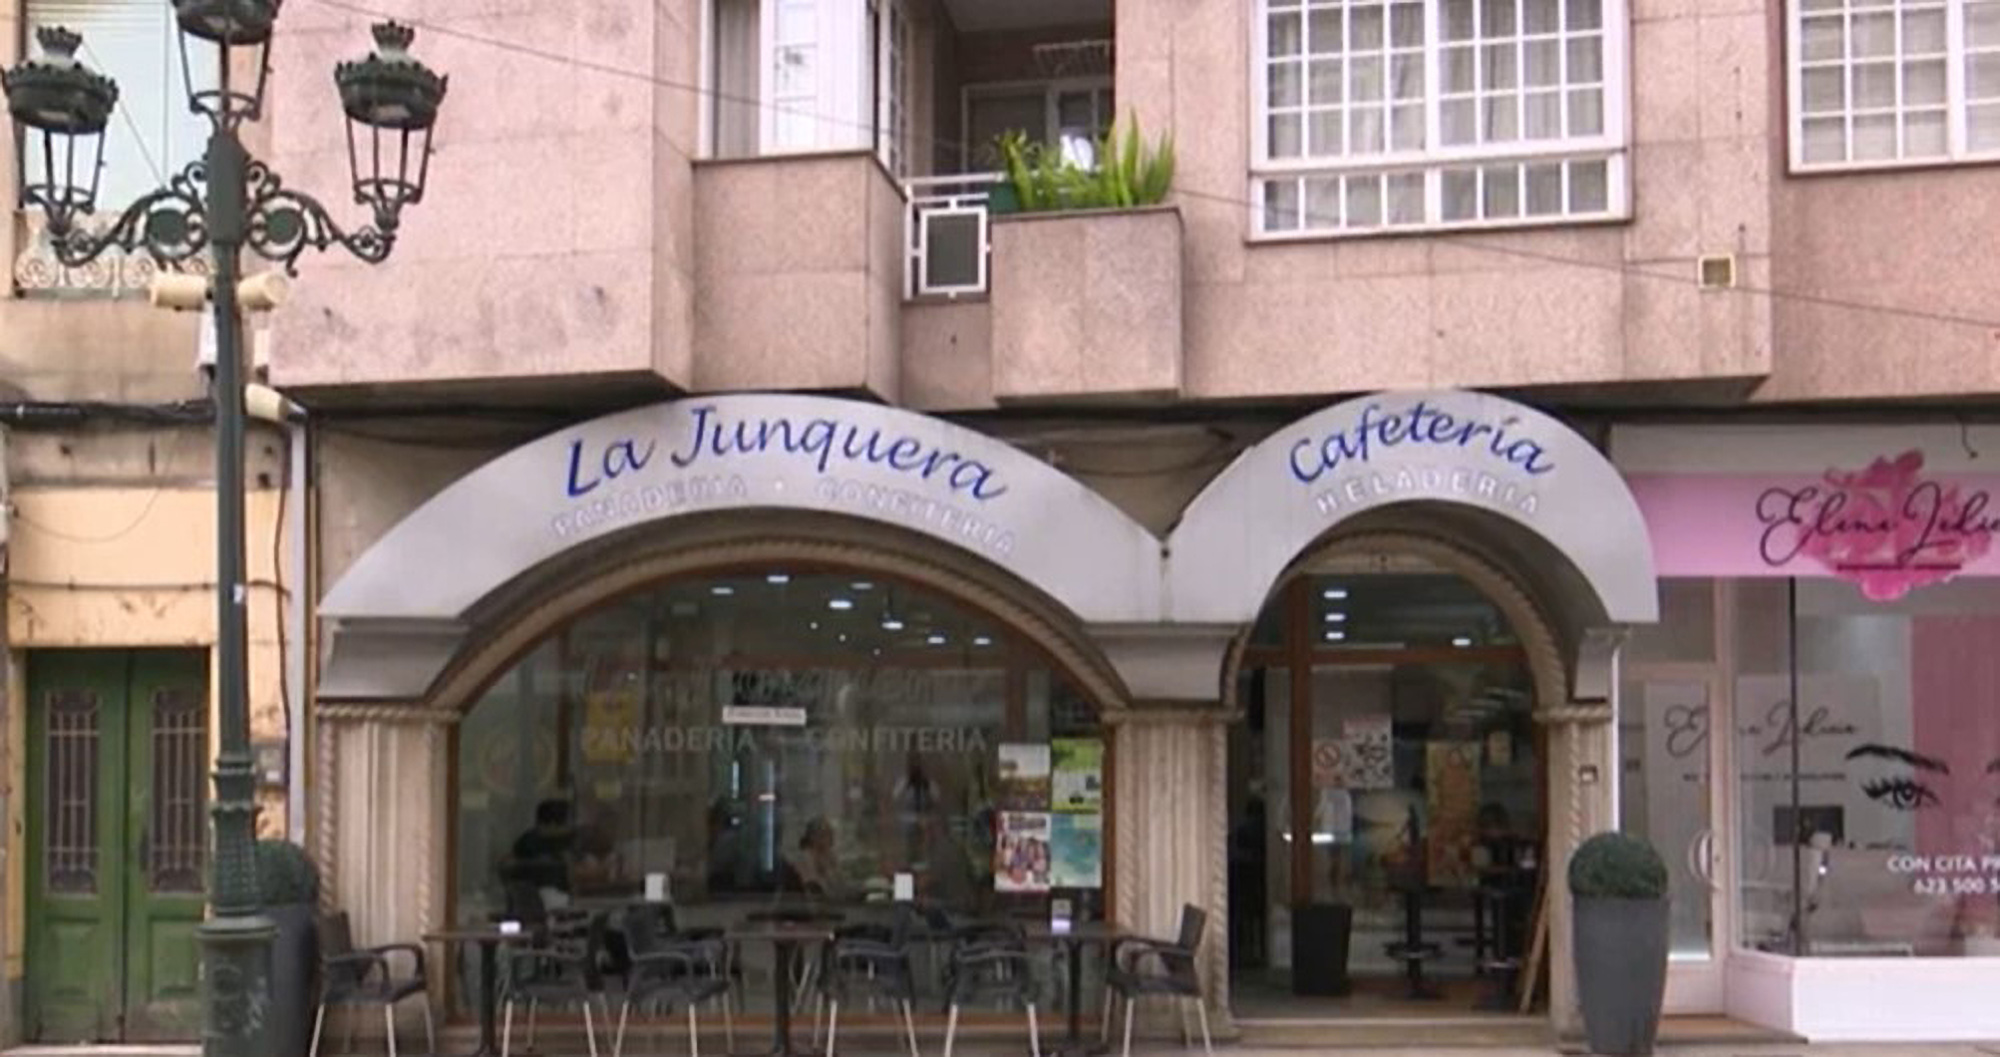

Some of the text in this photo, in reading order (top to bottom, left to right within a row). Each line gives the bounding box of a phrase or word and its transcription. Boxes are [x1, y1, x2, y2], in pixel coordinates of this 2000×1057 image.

[568, 405, 1007, 499] La Junquera
[1289, 401, 1555, 483] Cafetería
[1317, 468, 1538, 514] HELADERIA
[1887, 856, 1930, 873] CON
[1935, 856, 1976, 873] CITA
